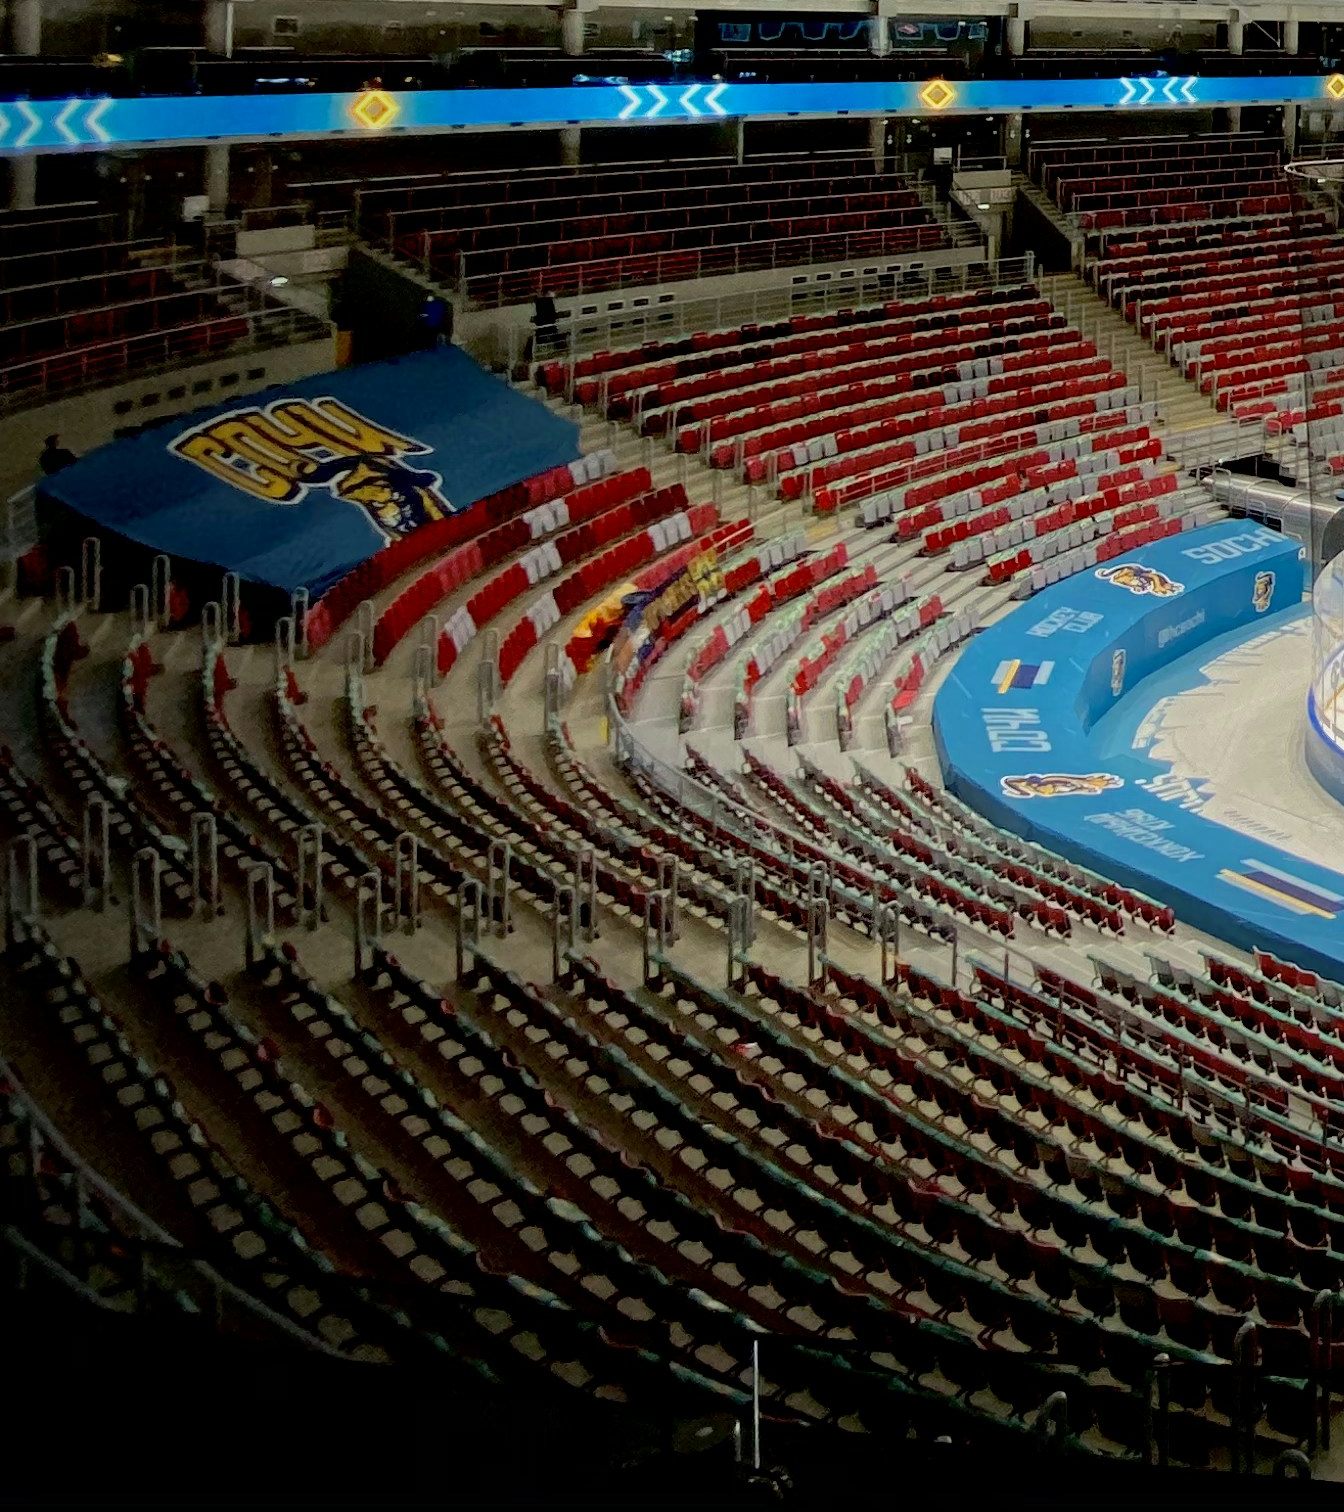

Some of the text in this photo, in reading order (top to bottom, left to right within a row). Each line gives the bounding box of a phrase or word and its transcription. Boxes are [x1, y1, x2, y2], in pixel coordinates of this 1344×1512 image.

[166, 396, 436, 506] СОЧИ
[1180, 527, 1290, 566] SOCHI
[980, 706, 1053, 753] СОЧИ
